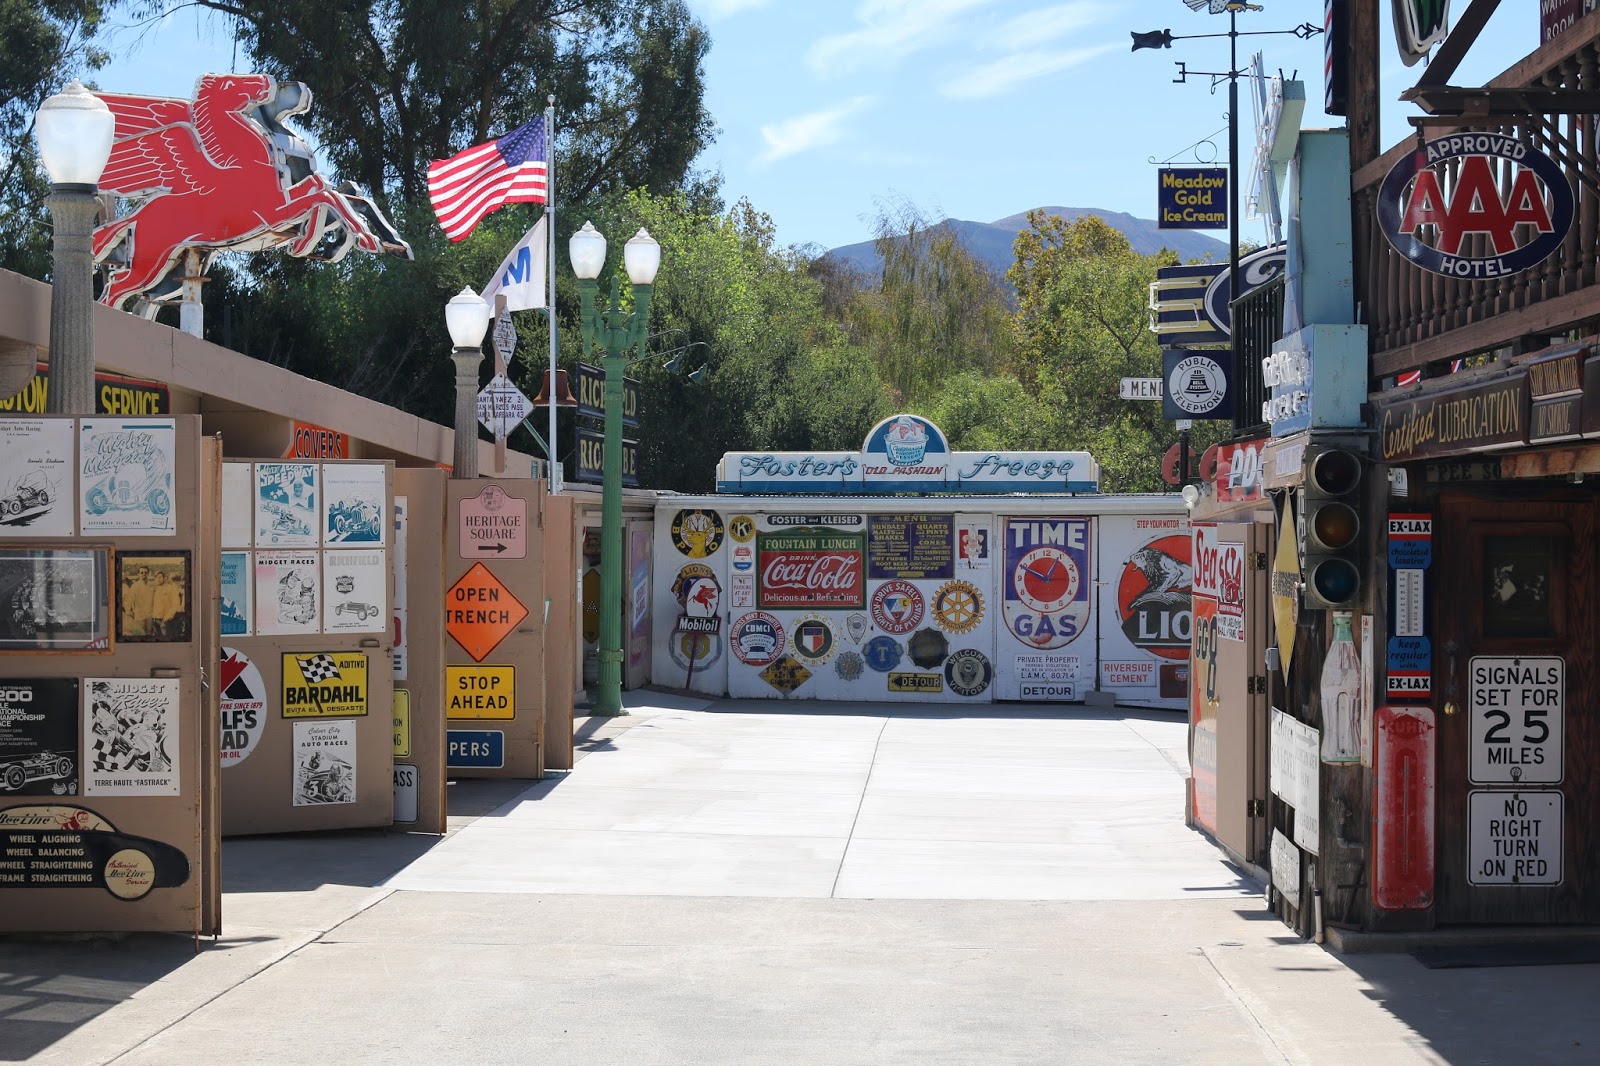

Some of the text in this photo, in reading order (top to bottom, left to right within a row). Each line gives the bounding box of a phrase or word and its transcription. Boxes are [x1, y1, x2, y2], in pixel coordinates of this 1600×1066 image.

[1547, 13, 1575, 41] ROOM
[1427, 136, 1527, 162] APPROVED
[1163, 173, 1225, 189] Meadow
[1174, 190, 1213, 206] Gold
[1398, 156, 1555, 256] AAA
[1164, 208, 1225, 222] Ice Cream
[1440, 257, 1512, 277] HOTEL
[1178, 358, 1218, 372] PUBLIC
[1529, 356, 1580, 396] STOP YOUR MOTOR
[101, 385, 160, 414] SERVICE
[1172, 390, 1224, 412] TELEPHONE
[1382, 388, 1520, 459] Certified LUBRICATION
[1537, 402, 1571, 436] NO SMOKING
[295, 428, 341, 458] COVERS
[740, 455, 858, 478] Foster's
[865, 466, 888, 475] OLD
[260, 466, 314, 487] SPEEDWAY
[466, 516, 521, 526] HERITAGE
[772, 516, 806, 524] FOSTER
[820, 516, 858, 524] KLEISER
[1137, 519, 1180, 529] STOP YOUR MOTOR
[1389, 521, 1430, 533] EX-LAX
[470, 529, 516, 540] SQUARE
[737, 522, 748, 537] K
[1009, 522, 1086, 551] TIME
[765, 539, 857, 549] FOUNTAIN LUNCH
[1391, 548, 1429, 556] chocolated
[329, 555, 380, 567] RICHFIELD
[1194, 529, 1217, 591] Sea
[1395, 556, 1425, 565] laxative
[684, 566, 711, 576] LIONS
[763, 555, 859, 589] Coca-Cola
[455, 588, 499, 601] OPEN
[764, 593, 799, 602] Delicious
[874, 582, 921, 602] DRIVE SAFELY
[447, 611, 509, 623] TRENCH
[873, 603, 922, 632] KNIGHTS OF PYTHIAS
[678, 618, 719, 632] Mobiloil
[745, 624, 771, 632] CBMCI
[1014, 615, 1077, 637] GAS
[1398, 637, 1421, 649] keep
[877, 647, 888, 662] T
[948, 649, 988, 666] WELCOME
[1391, 651, 1428, 661] regular
[339, 661, 365, 669] ADITIVO
[1104, 663, 1153, 672] RIVERSIDE
[459, 677, 500, 689] STOP
[901, 677, 940, 687] DETOUR
[1110, 674, 1148, 683] CEMENT
[1475, 667, 1559, 685] SIGNALS
[113, 684, 166, 694] MIDGET
[1388, 678, 1430, 689] EX-LAX
[1024, 686, 1072, 696] DETOUR
[1475, 689, 1558, 706] SET FOR
[286, 685, 364, 713] BARDAHL
[451, 696, 508, 709] AHEAD
[308, 726, 341, 735] Culver City
[1484, 710, 1549, 744] 25
[450, 742, 490, 756] PERS
[1487, 748, 1545, 765] MILES
[94, 779, 113, 787] TERRE
[134, 778, 171, 786] "FASTRACK"
[309, 781, 319, 796] 3
[1504, 800, 1528, 817] NO
[1490, 820, 1542, 837] RIGHT
[9, 835, 81, 843] WHEEL ALIGNING
[6, 848, 84, 856] WHEEL BALANCING
[1493, 840, 1539, 856] TURN
[0, 861, 93, 869] WHEEL STRAIGHTENING
[108, 859, 139, 871] Authorized
[1483, 860, 1547, 877] ON RED
[0, 874, 93, 882] FRAME STRAIGHTENING
